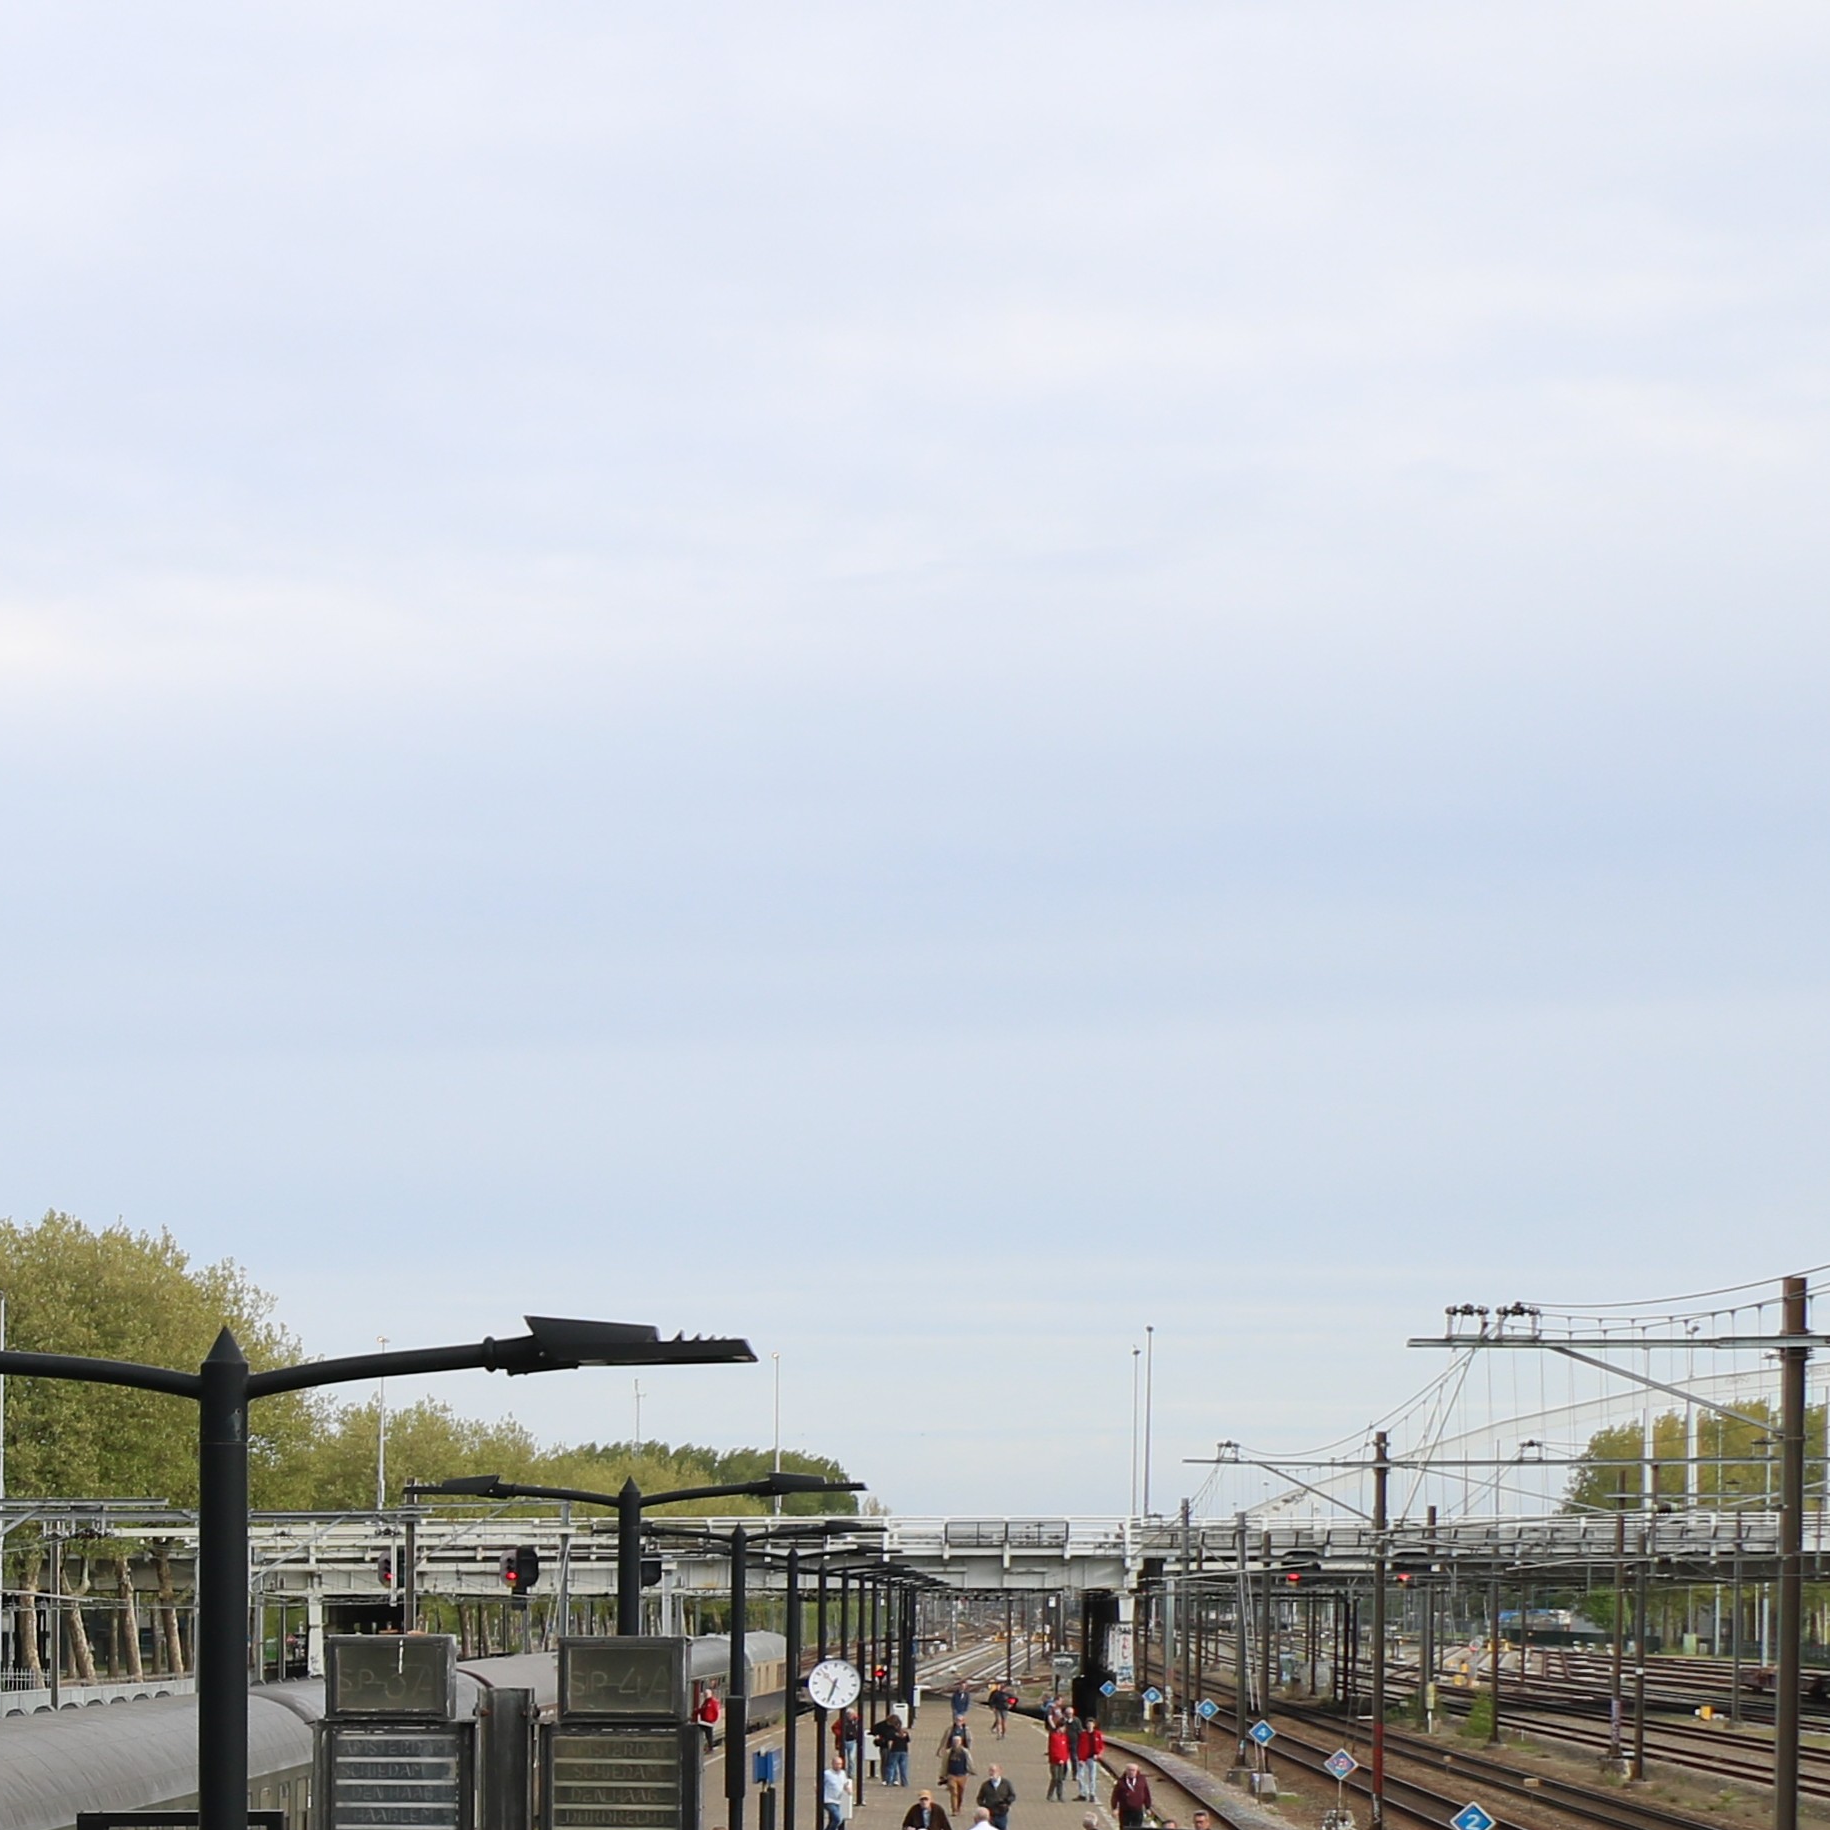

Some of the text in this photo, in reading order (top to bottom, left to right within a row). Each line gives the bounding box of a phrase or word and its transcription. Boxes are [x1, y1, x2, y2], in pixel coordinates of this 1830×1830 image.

[1205, 1704, 1212, 1714] 5
[1257, 1727, 1267, 1738] 4
[1465, 1814, 1481, 1830] 2
